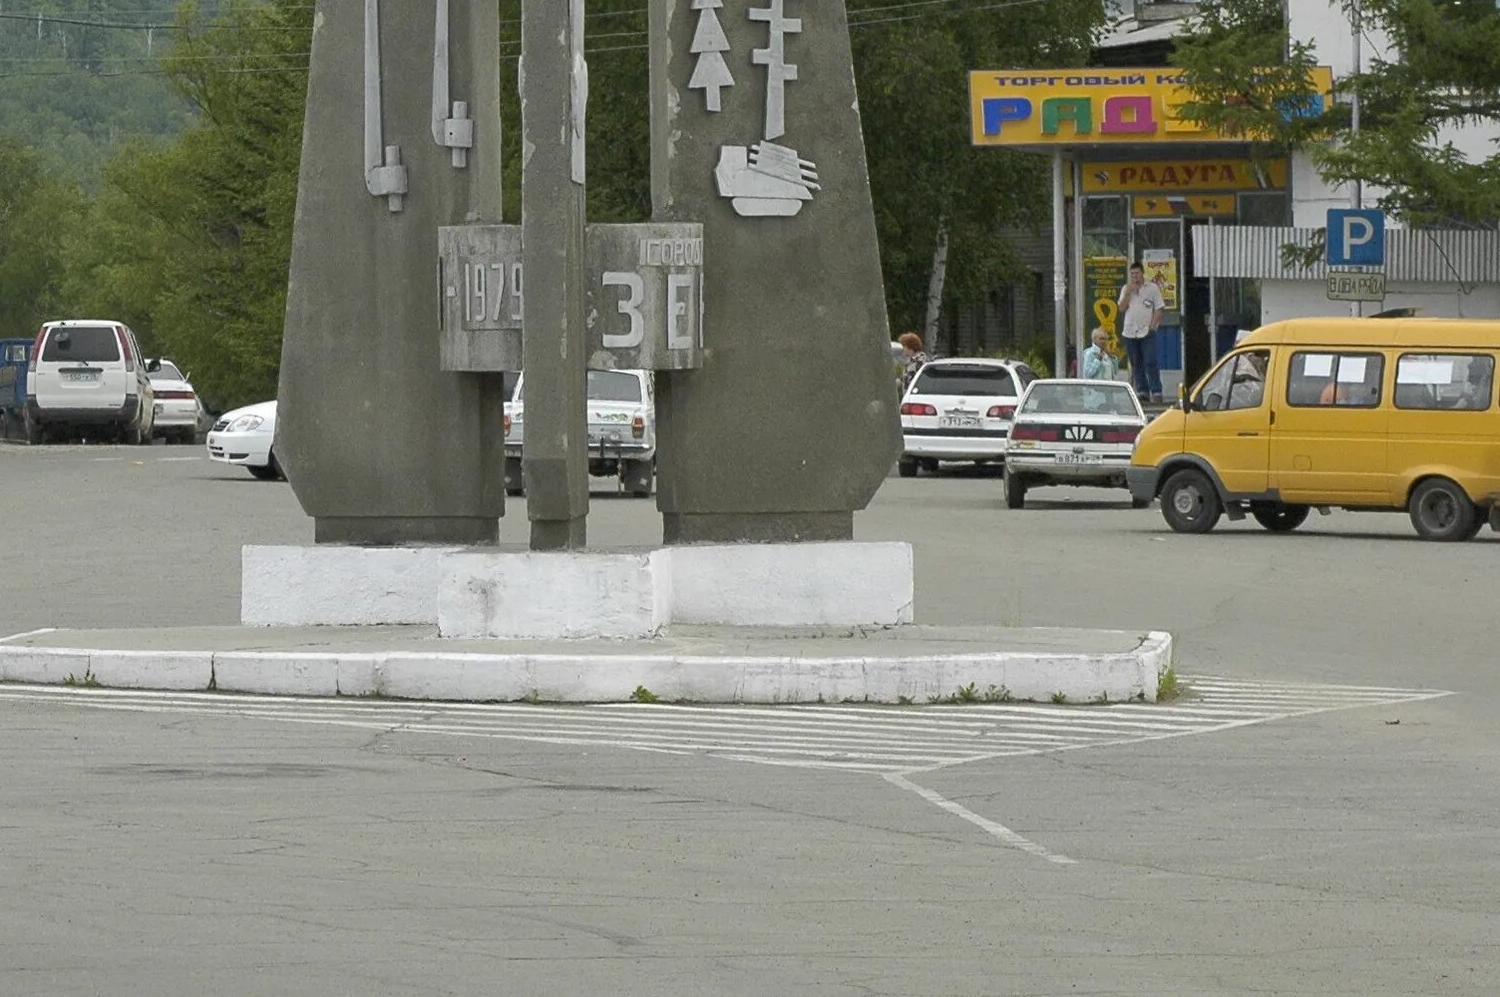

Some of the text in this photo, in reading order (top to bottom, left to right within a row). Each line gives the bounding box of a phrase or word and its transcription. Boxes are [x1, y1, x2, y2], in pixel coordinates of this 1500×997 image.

[993, 73, 1146, 87] ТОРГОВЫЙ
[1119, 164, 1237, 187] РАДУГА
[1343, 216, 1374, 260] P
